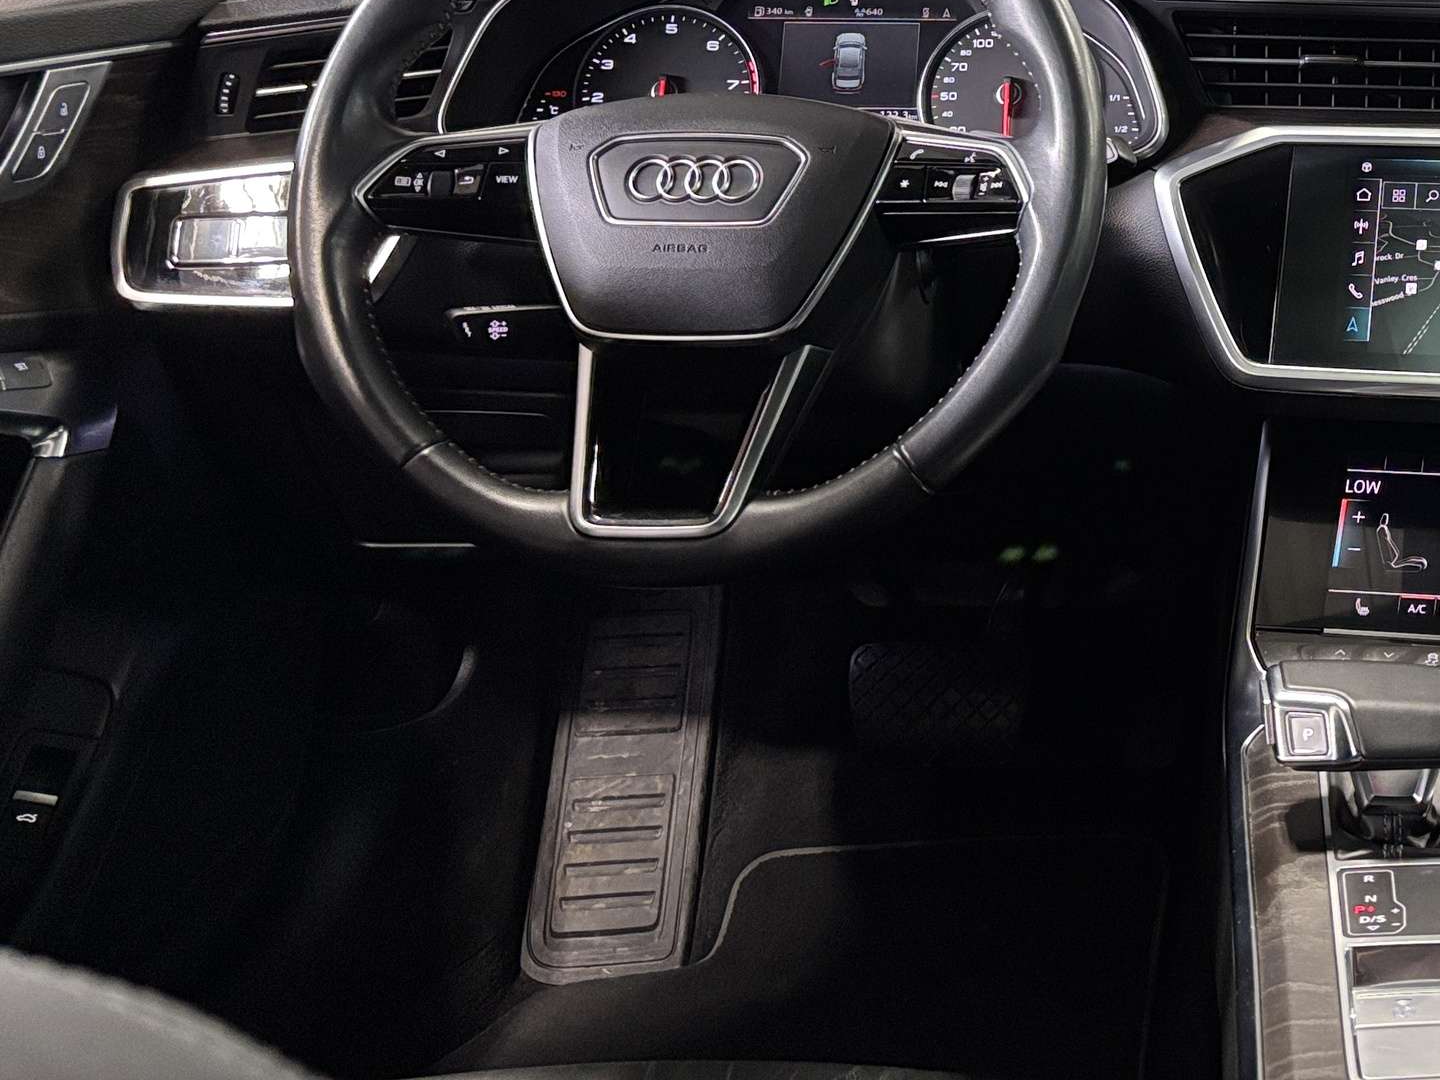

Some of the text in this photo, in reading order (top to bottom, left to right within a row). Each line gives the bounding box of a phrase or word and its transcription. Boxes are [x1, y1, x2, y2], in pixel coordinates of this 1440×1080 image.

[766, 7, 783, 15] 340
[665, 23, 678, 34] 5
[623, 34, 637, 44] 4
[972, 39, 994, 48] 100
[706, 40, 720, 51] 6
[600, 59, 614, 70] 3
[951, 62, 968, 71] 70
[726, 79, 739, 90] 7
[590, 92, 604, 103] 2
[940, 91, 957, 101] 50
[495, 175, 518, 184] VIEW
[652, 243, 708, 253] AIRBAG
[1345, 479, 1381, 495] LOW
[1407, 604, 1427, 615] A/C
[1302, 727, 1314, 742] P
[1363, 875, 1375, 883] R
[1364, 894, 1377, 903] N
[1359, 915, 1387, 924] D/S
